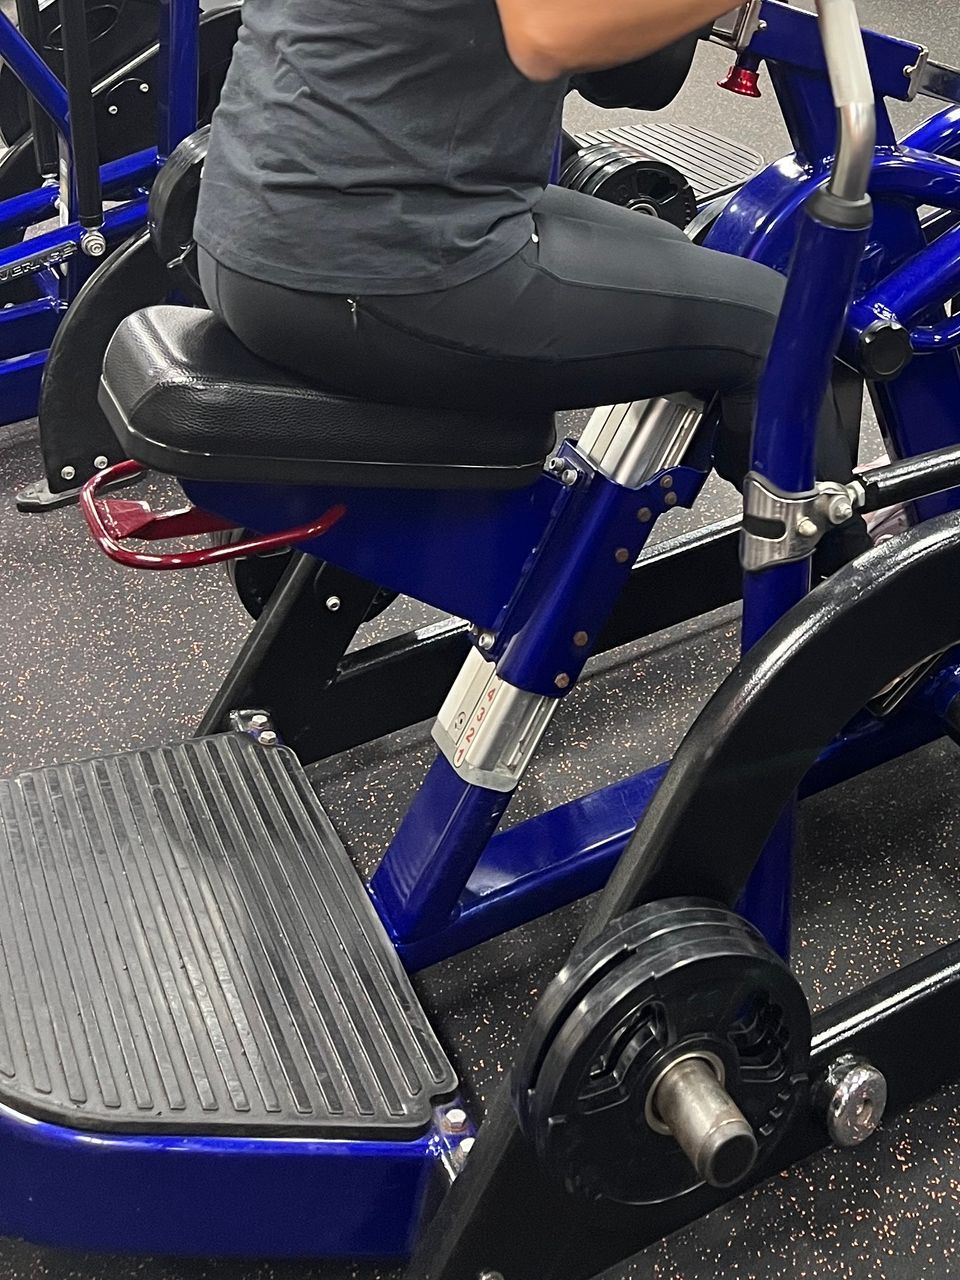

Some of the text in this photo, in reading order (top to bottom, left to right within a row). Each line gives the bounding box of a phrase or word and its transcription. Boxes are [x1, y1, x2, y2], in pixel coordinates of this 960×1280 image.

[487, 688, 496, 703] 4
[476, 706, 486, 722] 3
[465, 726, 475, 743] 2
[456, 748, 465, 763] 1
